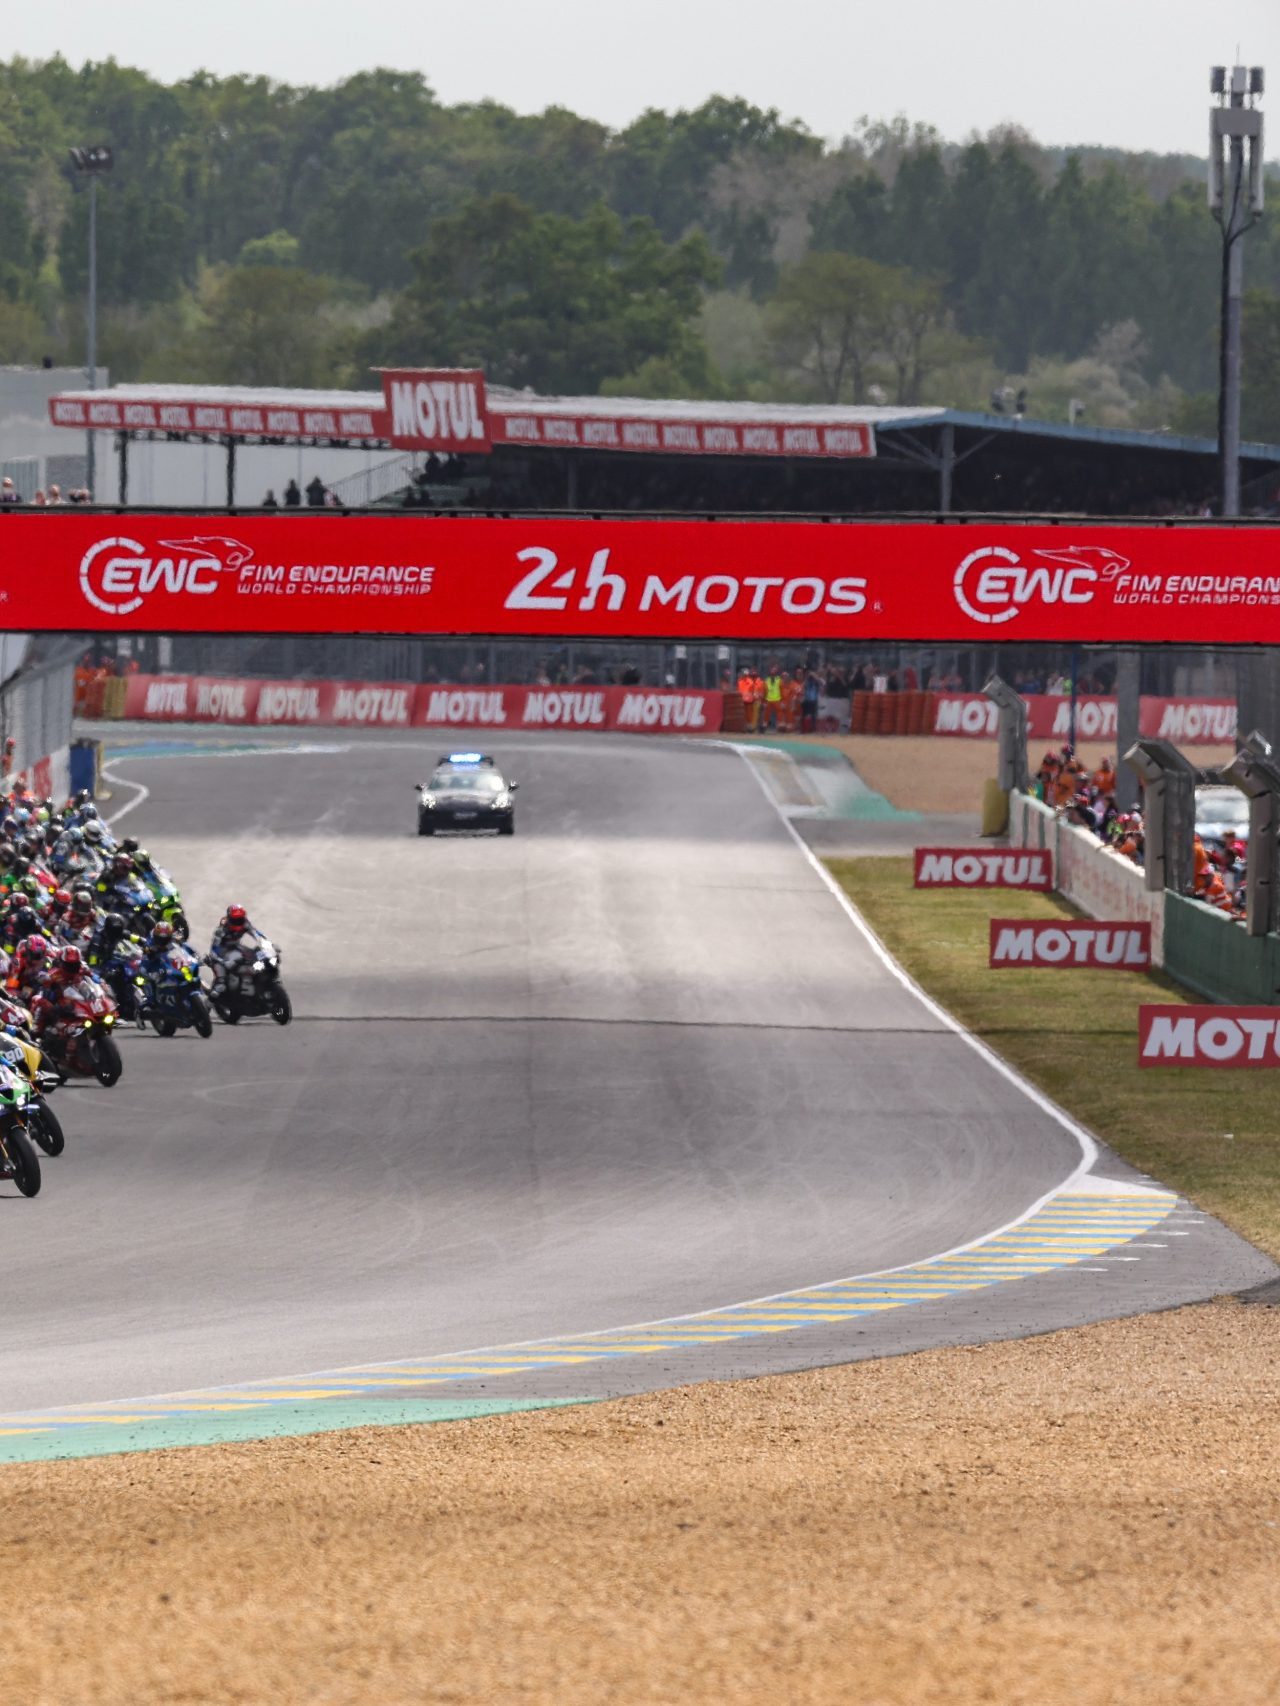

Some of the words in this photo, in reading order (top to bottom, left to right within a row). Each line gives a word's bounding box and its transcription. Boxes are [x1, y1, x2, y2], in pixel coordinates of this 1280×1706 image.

[391, 381, 486, 440] MOTUL
[237, 584, 296, 594] WORLD
[301, 584, 431, 595] CHAMPIONSHIP
[239, 565, 284, 581] FIM
[289, 565, 435, 582] ENDURANCE
[504, 547, 626, 611] 24h
[639, 575, 867, 614] MOTOS
[1116, 575, 1162, 591] FIM
[1113, 593, 1173, 604] WORLD
[332, 689, 408, 722] MOTUL
[426, 690, 507, 723] MOTUL
[522, 692, 604, 724] MOTUL
[617, 694, 705, 726] MOTUL
[1052, 702, 1117, 735] MOT
[919, 855, 1047, 884] MOTUL
[993, 928, 1148, 964] MOTUL
[1142, 1016, 1280, 1060] MOT
